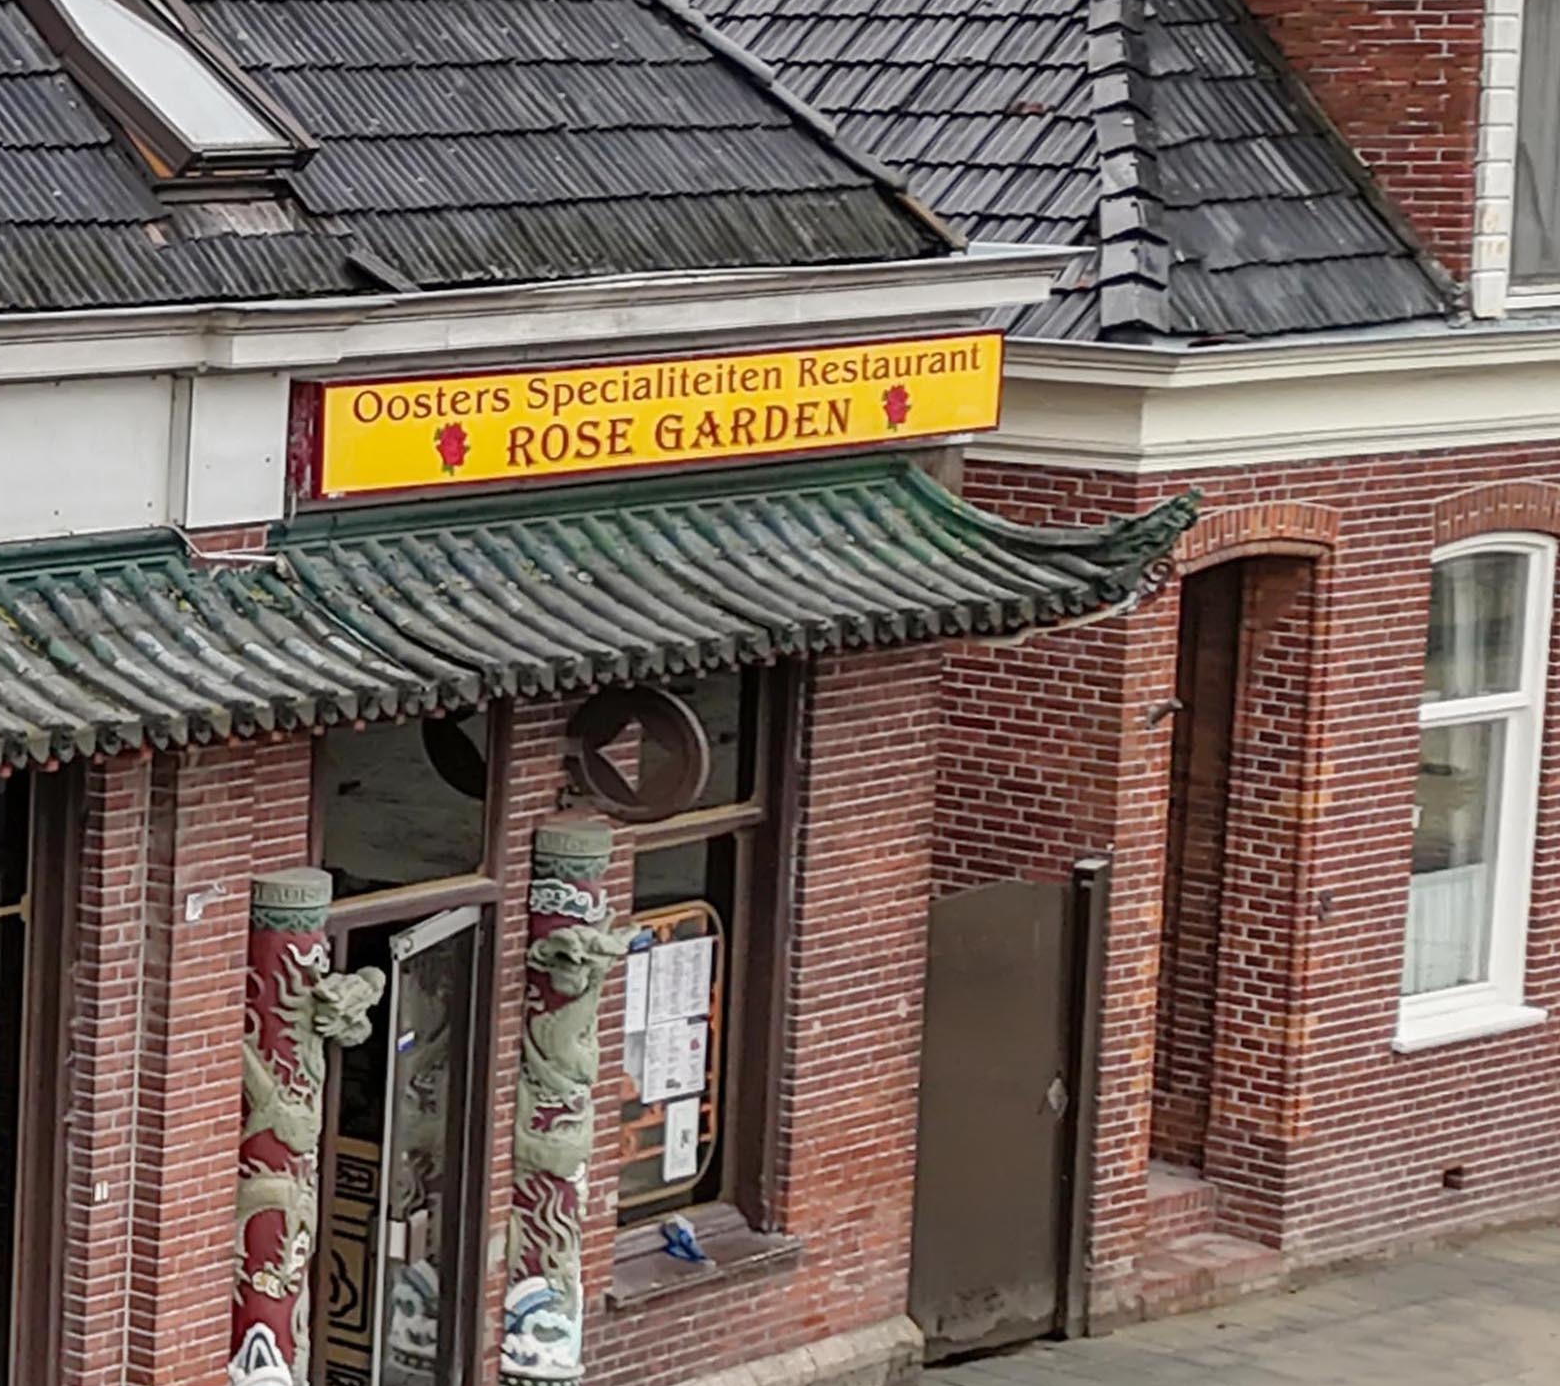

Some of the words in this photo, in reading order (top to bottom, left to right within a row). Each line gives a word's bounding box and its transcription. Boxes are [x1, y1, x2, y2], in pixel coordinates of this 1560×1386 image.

[353, 384, 510, 424] Oosters
[527, 364, 782, 416] Specialiteiten
[798, 341, 982, 386] Restaurant
[507, 416, 634, 468] ROSE
[654, 397, 852, 451] GARDEN
